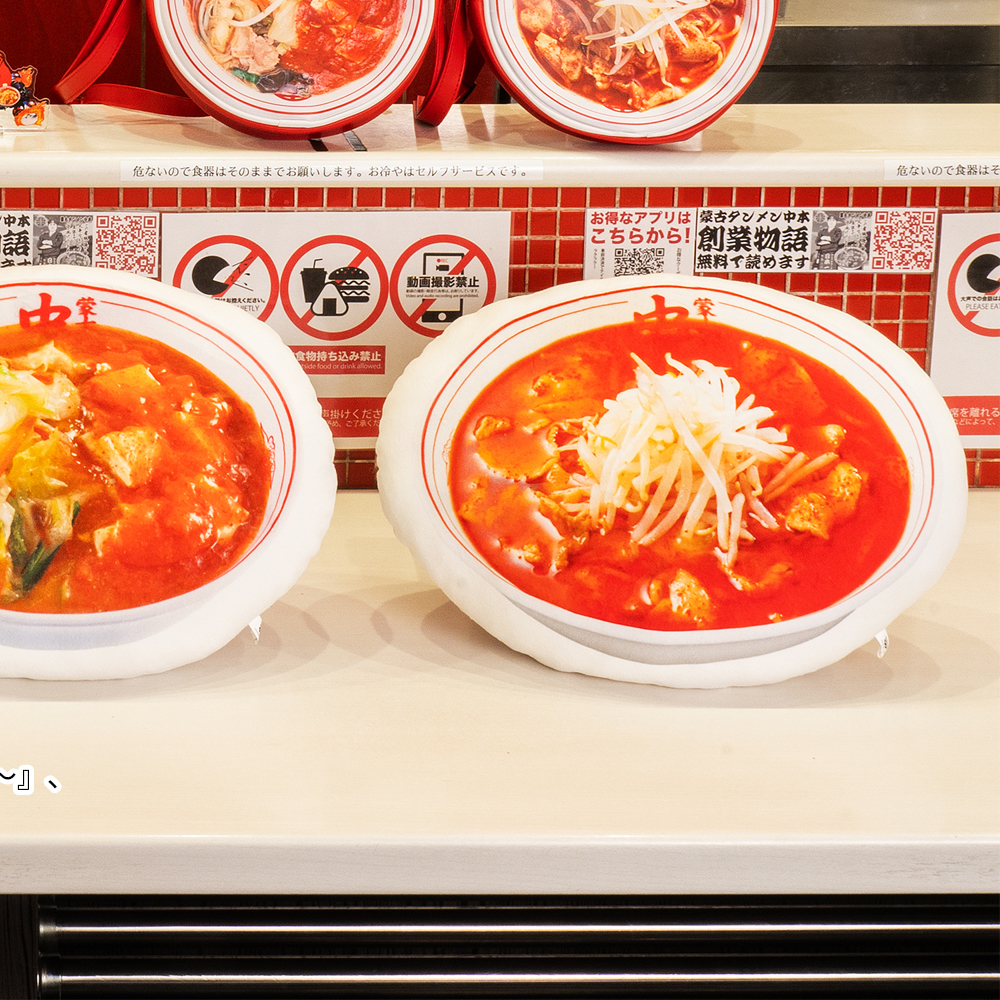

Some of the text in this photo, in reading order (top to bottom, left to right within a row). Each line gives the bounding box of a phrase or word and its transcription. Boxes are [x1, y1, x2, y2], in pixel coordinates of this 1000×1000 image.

[132, 164, 527, 178] 危ないので食器はそのままでお願いします。お冷やはセルフサービスです。
[896, 164, 1000, 177] 危ないので食器はそ
[590, 211, 692, 226] お得なアプリは
[699, 209, 811, 224] 蒙古タンメン中本
[590, 227, 691, 245] こちらから！
[697, 225, 809, 253] 創業物語
[696, 254, 810, 270] 無料で読めます
[406, 275, 480, 288] 動画撮影禁止
